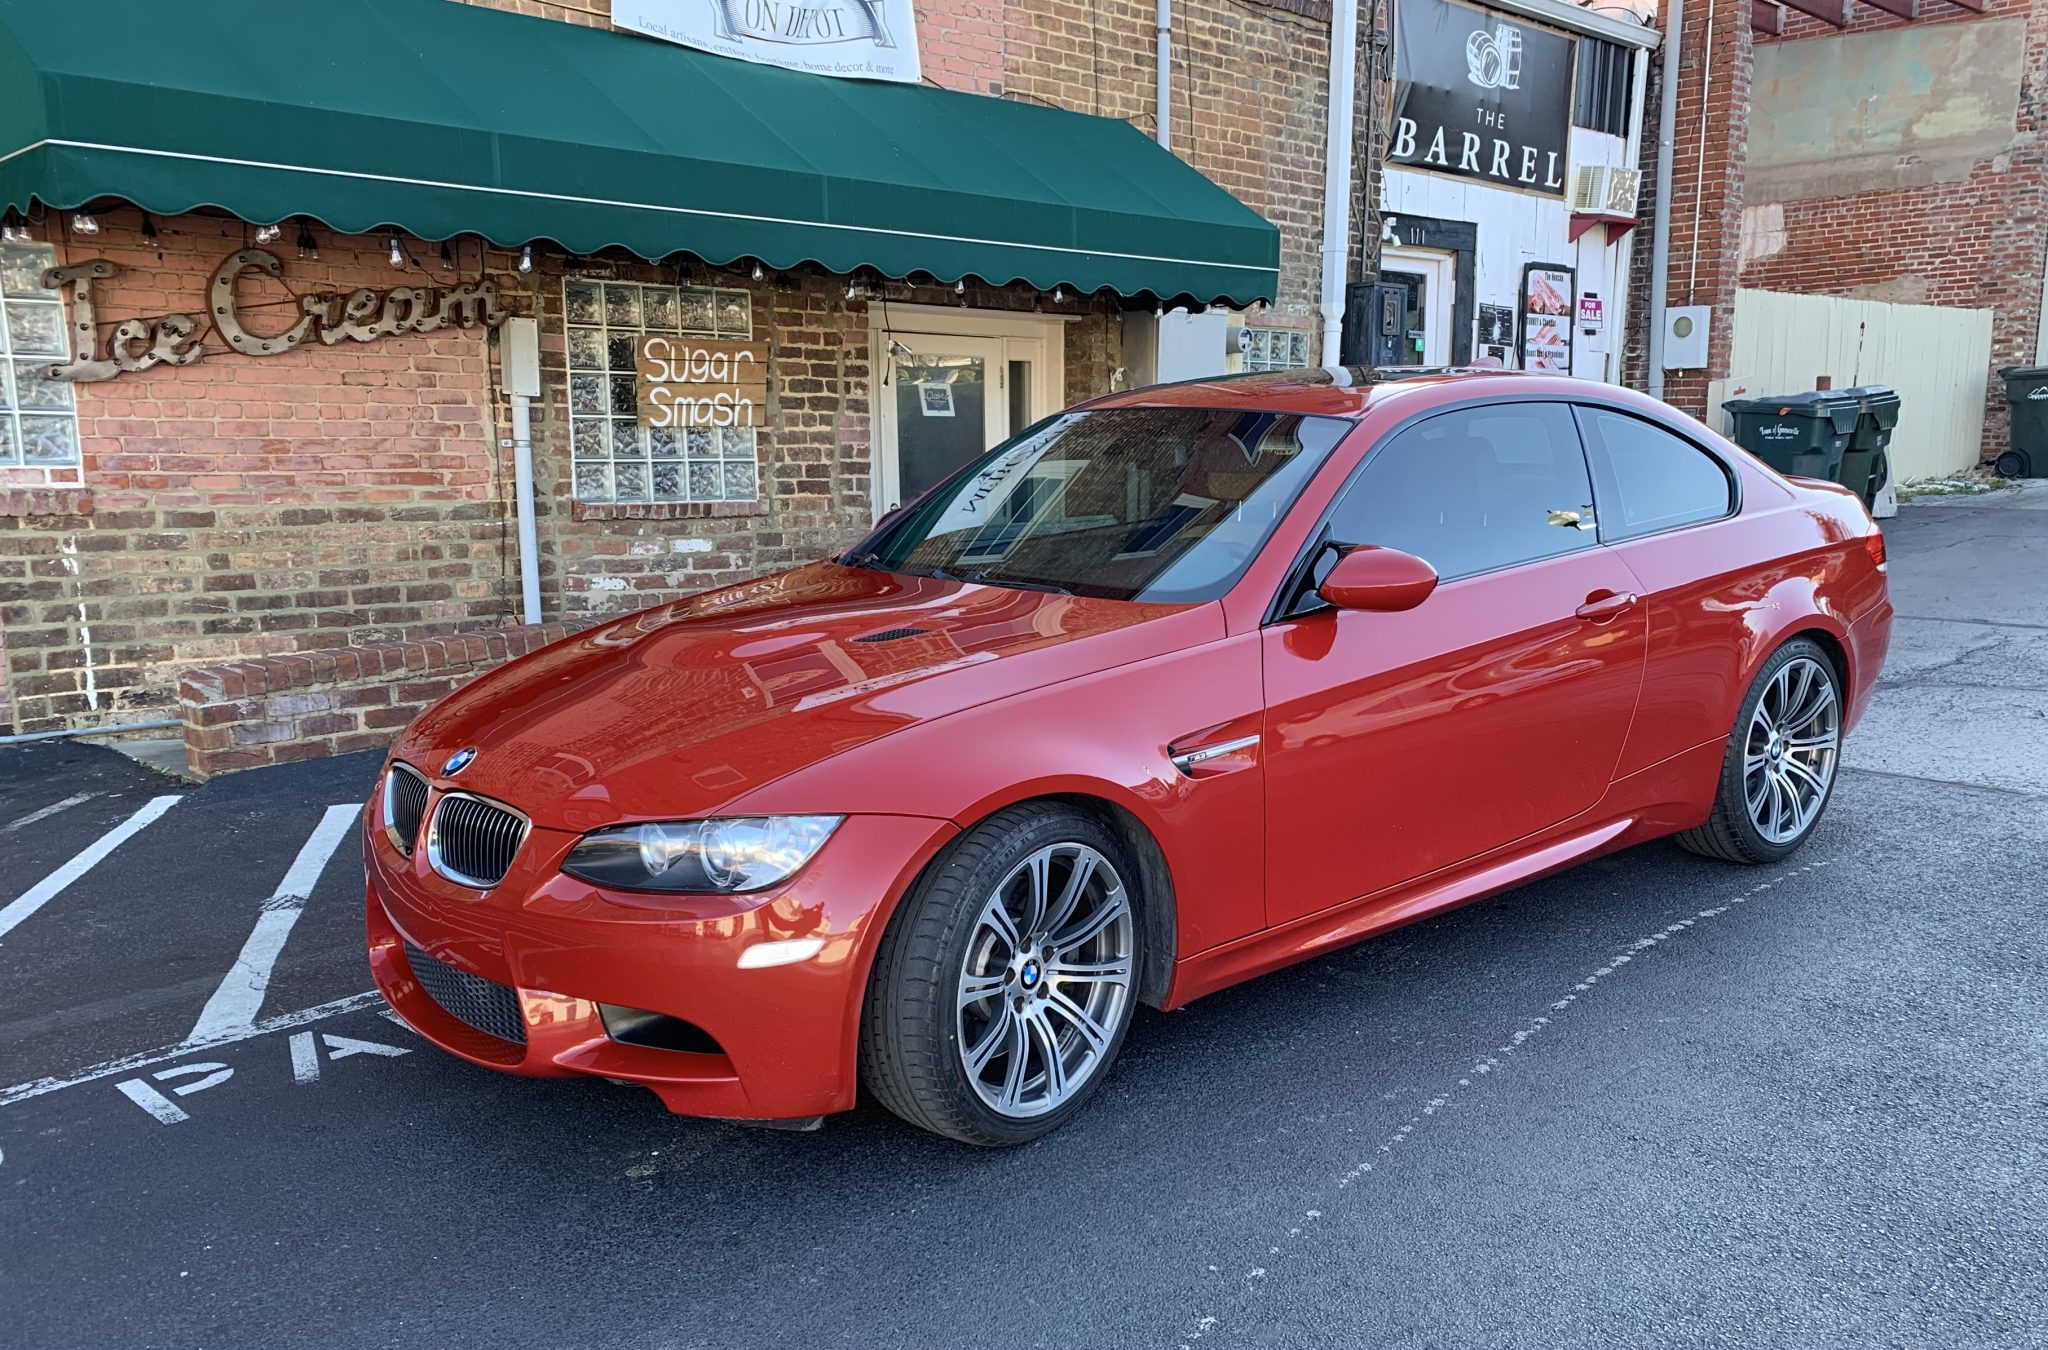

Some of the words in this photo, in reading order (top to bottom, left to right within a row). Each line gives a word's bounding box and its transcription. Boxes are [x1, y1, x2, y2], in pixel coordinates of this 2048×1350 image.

[785, 6, 845, 39] DEPOT
[638, 15, 668, 36] Local
[803, 60, 832, 73] home
[834, 61, 863, 73] decor
[865, 60, 874, 73] &
[875, 65, 895, 75] more
[1476, 108, 1506, 130] THE
[1391, 117, 1562, 189] BARREL
[40, 257, 204, 383] Ice
[205, 247, 510, 356] Cream
[1580, 309, 1602, 320] SALE
[1584, 301, 1596, 309] FOR
[643, 337, 755, 384] Sugar
[649, 386, 753, 427] Smash
